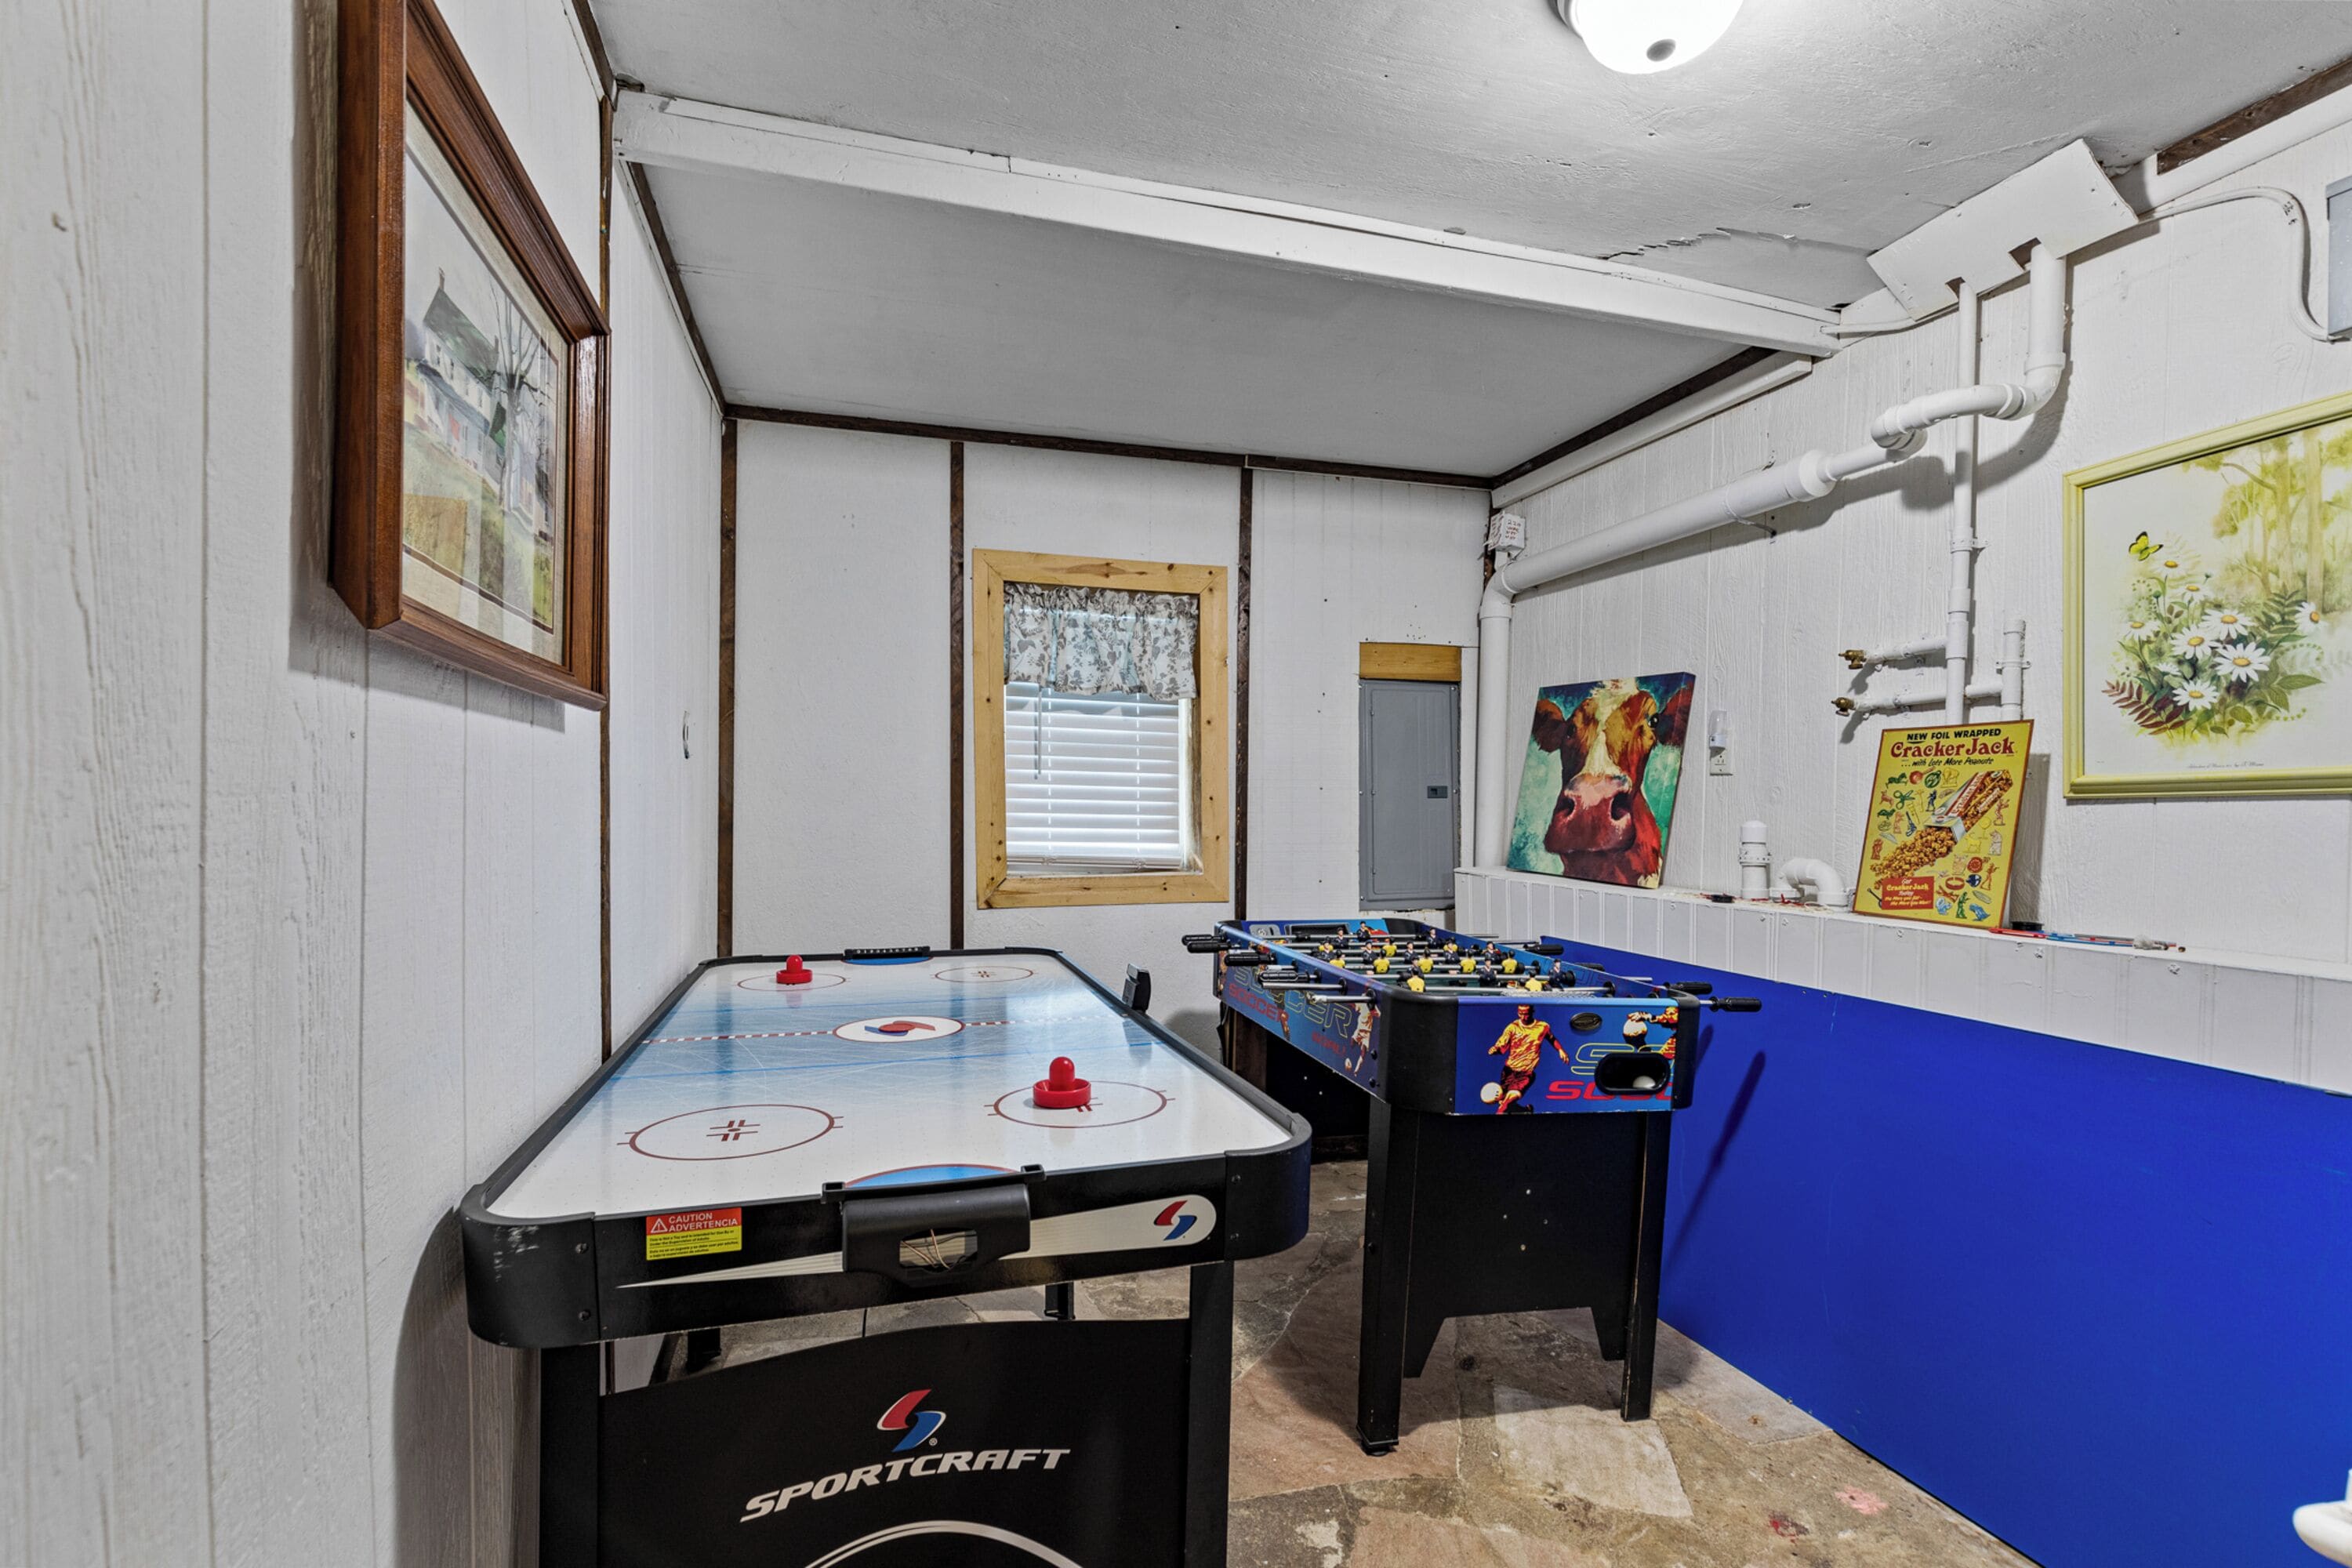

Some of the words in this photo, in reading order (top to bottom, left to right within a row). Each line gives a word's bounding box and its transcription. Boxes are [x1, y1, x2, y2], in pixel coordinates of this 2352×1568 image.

[1907, 732, 1927, 741] NEW
[1931, 731, 1950, 740] FOIL
[1954, 728, 2002, 739] WRAPPED
[1890, 740, 1965, 758] Cracker
[1965, 736, 2015, 755] Jack
[1928, 758, 1942, 767] Lots
[1944, 757, 1962, 766] More
[1964, 757, 1994, 765] Peanuts
[669, 1212, 713, 1224] CAUTION
[668, 1218, 738, 1232] ADVERTENCIA
[739, 1449, 1071, 1523] SPORTCRAFT
